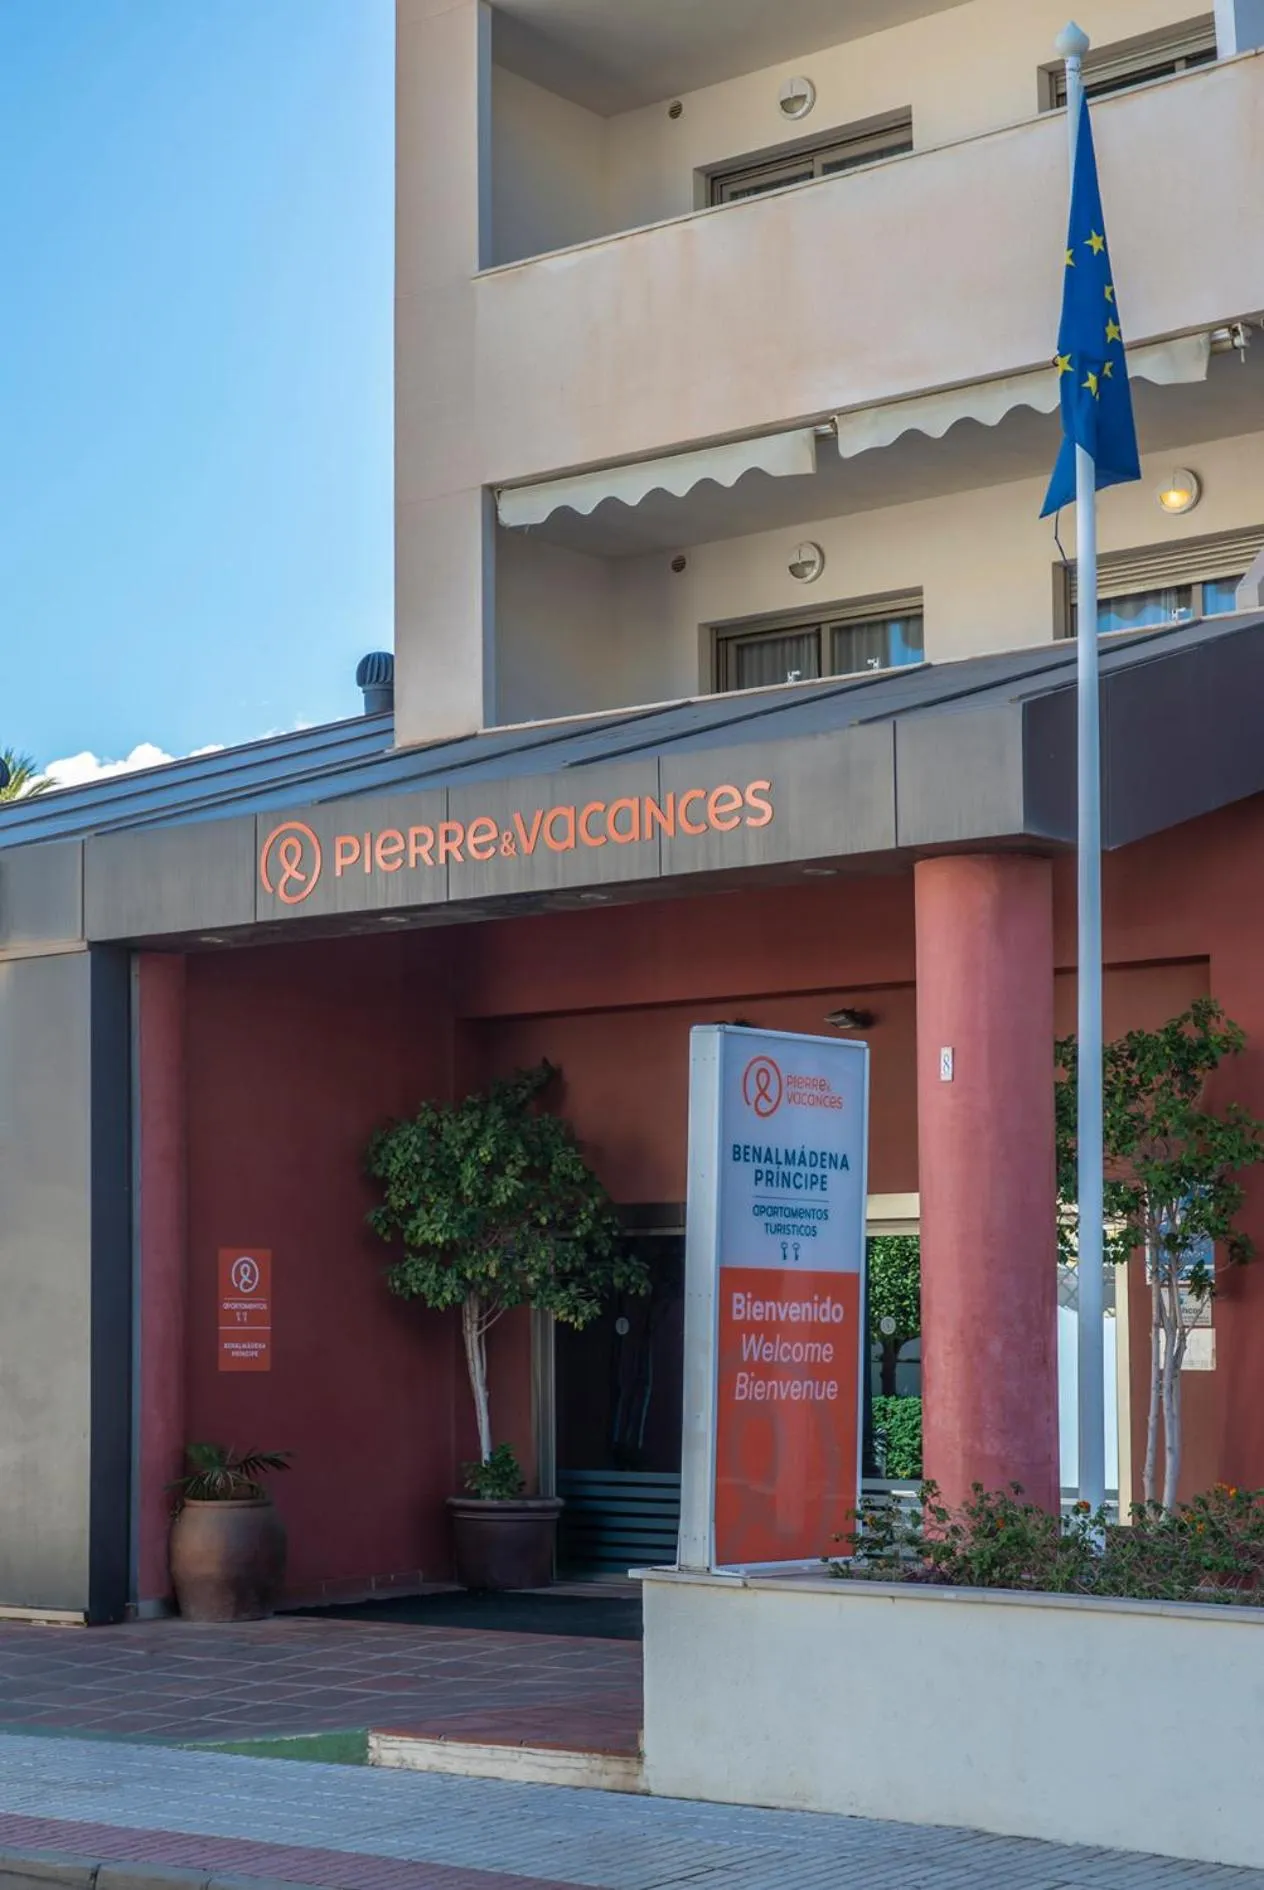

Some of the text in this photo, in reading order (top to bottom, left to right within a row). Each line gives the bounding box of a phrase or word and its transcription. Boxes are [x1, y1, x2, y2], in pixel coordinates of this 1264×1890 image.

[732, 1144, 850, 1171] BENALMÁDENA
[754, 1167, 828, 1191] PRÍNCIPE
[732, 1292, 844, 1323] Bienvenido
[742, 1333, 834, 1363] Welcome
[735, 1372, 838, 1400] Bienvenue
